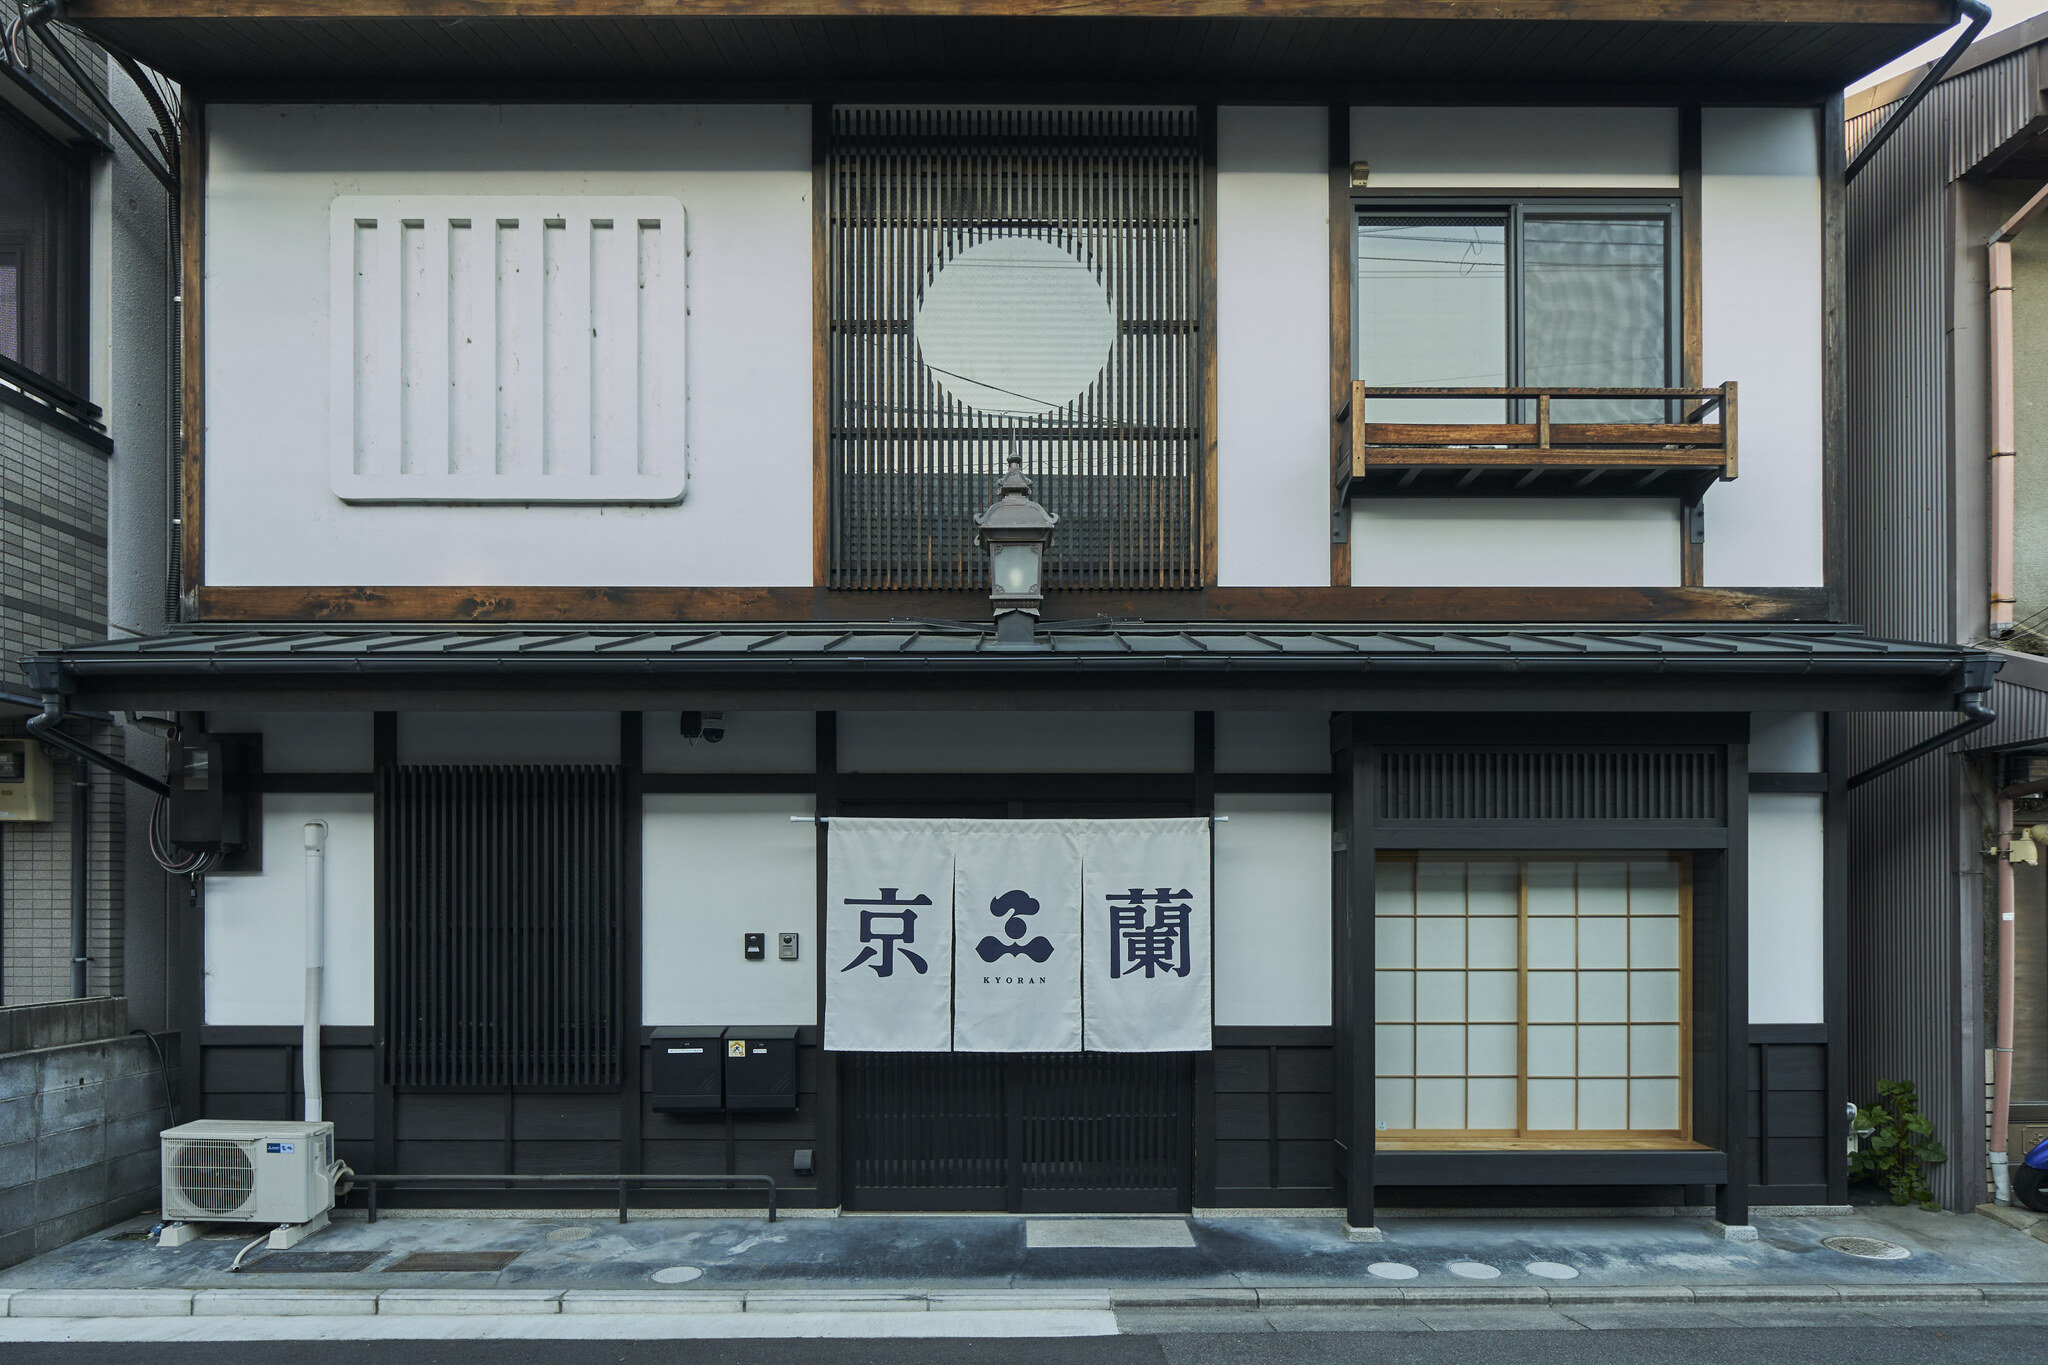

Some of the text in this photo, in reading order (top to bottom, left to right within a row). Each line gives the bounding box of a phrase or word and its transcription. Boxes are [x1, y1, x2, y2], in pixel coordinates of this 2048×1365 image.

[841, 888, 1193, 979] 京 蘭
[983, 976, 1047, 984] KYORAN
